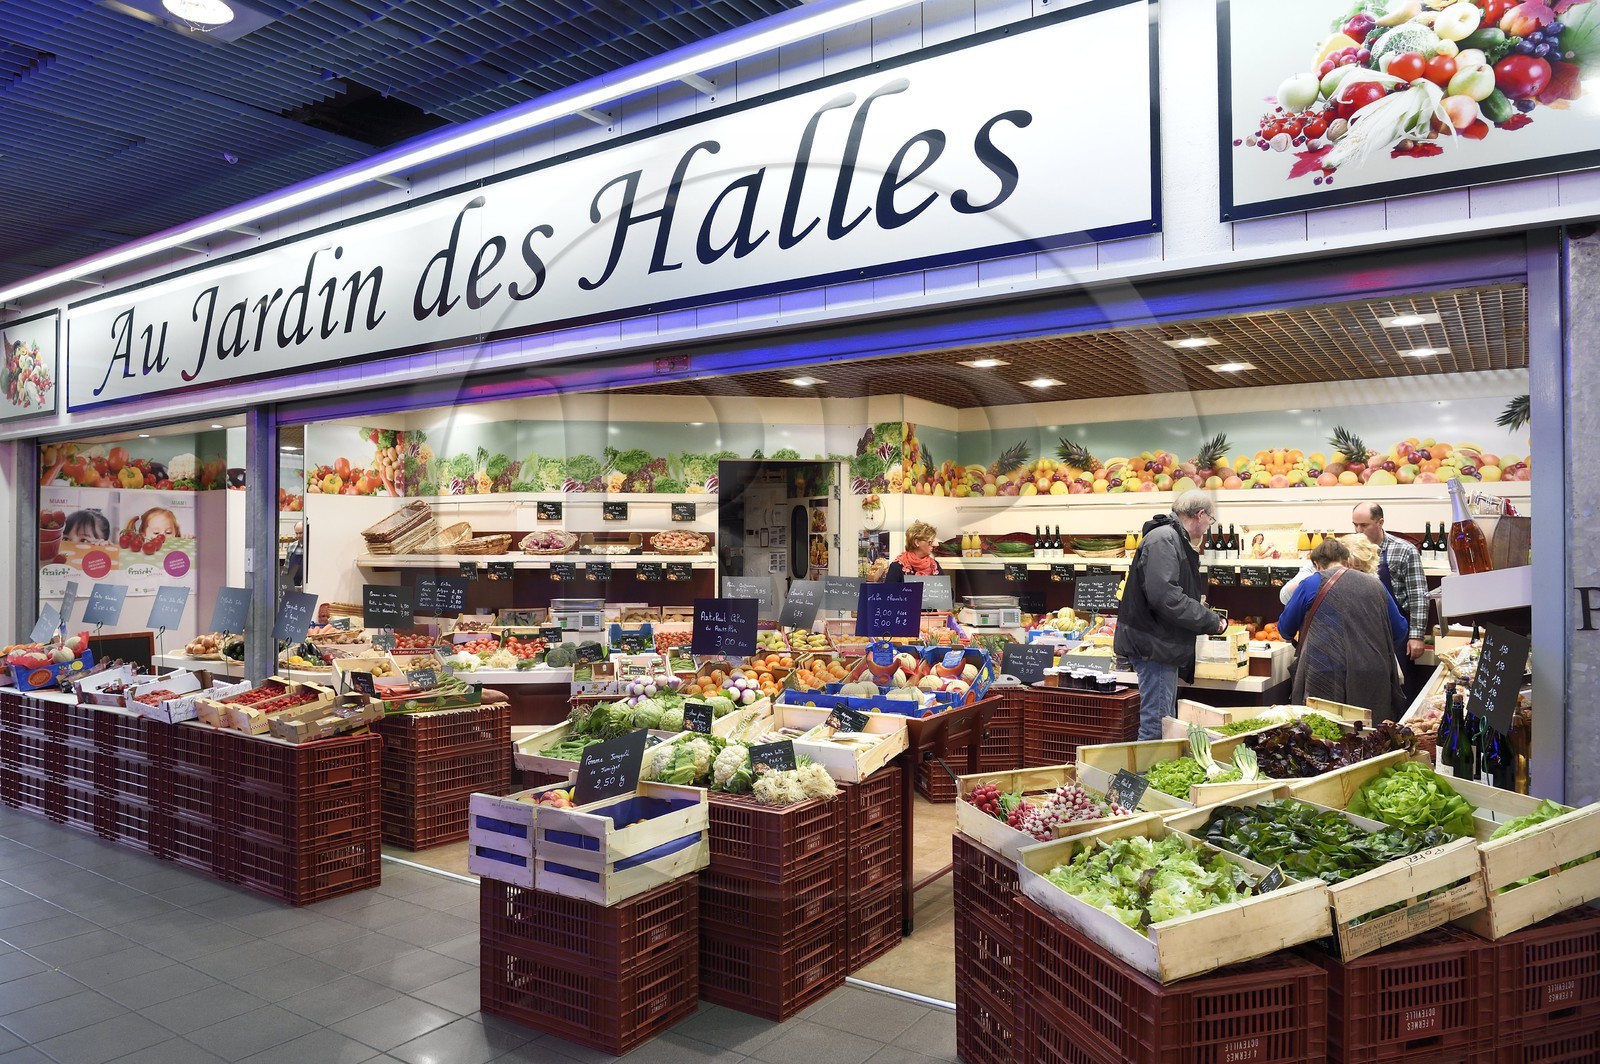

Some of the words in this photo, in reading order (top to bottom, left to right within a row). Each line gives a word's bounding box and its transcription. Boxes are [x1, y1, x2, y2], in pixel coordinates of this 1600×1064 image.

[92, 306, 169, 396] Au
[180, 240, 387, 382] Jardin
[412, 195, 554, 324] des
[577, 76, 1033, 291] Halles
[874, 607, 892, 618] 3,00
[873, 619, 891, 628] 5,00
[593, 776, 616, 790] 2,50
[1406, 1007, 1436, 1021] OCTEVILLE
[1407, 1018, 1429, 1031] FERMES
[1224, 1038, 1259, 1052] OCTEVILLE
[1226, 1050, 1252, 1063] FERMES
